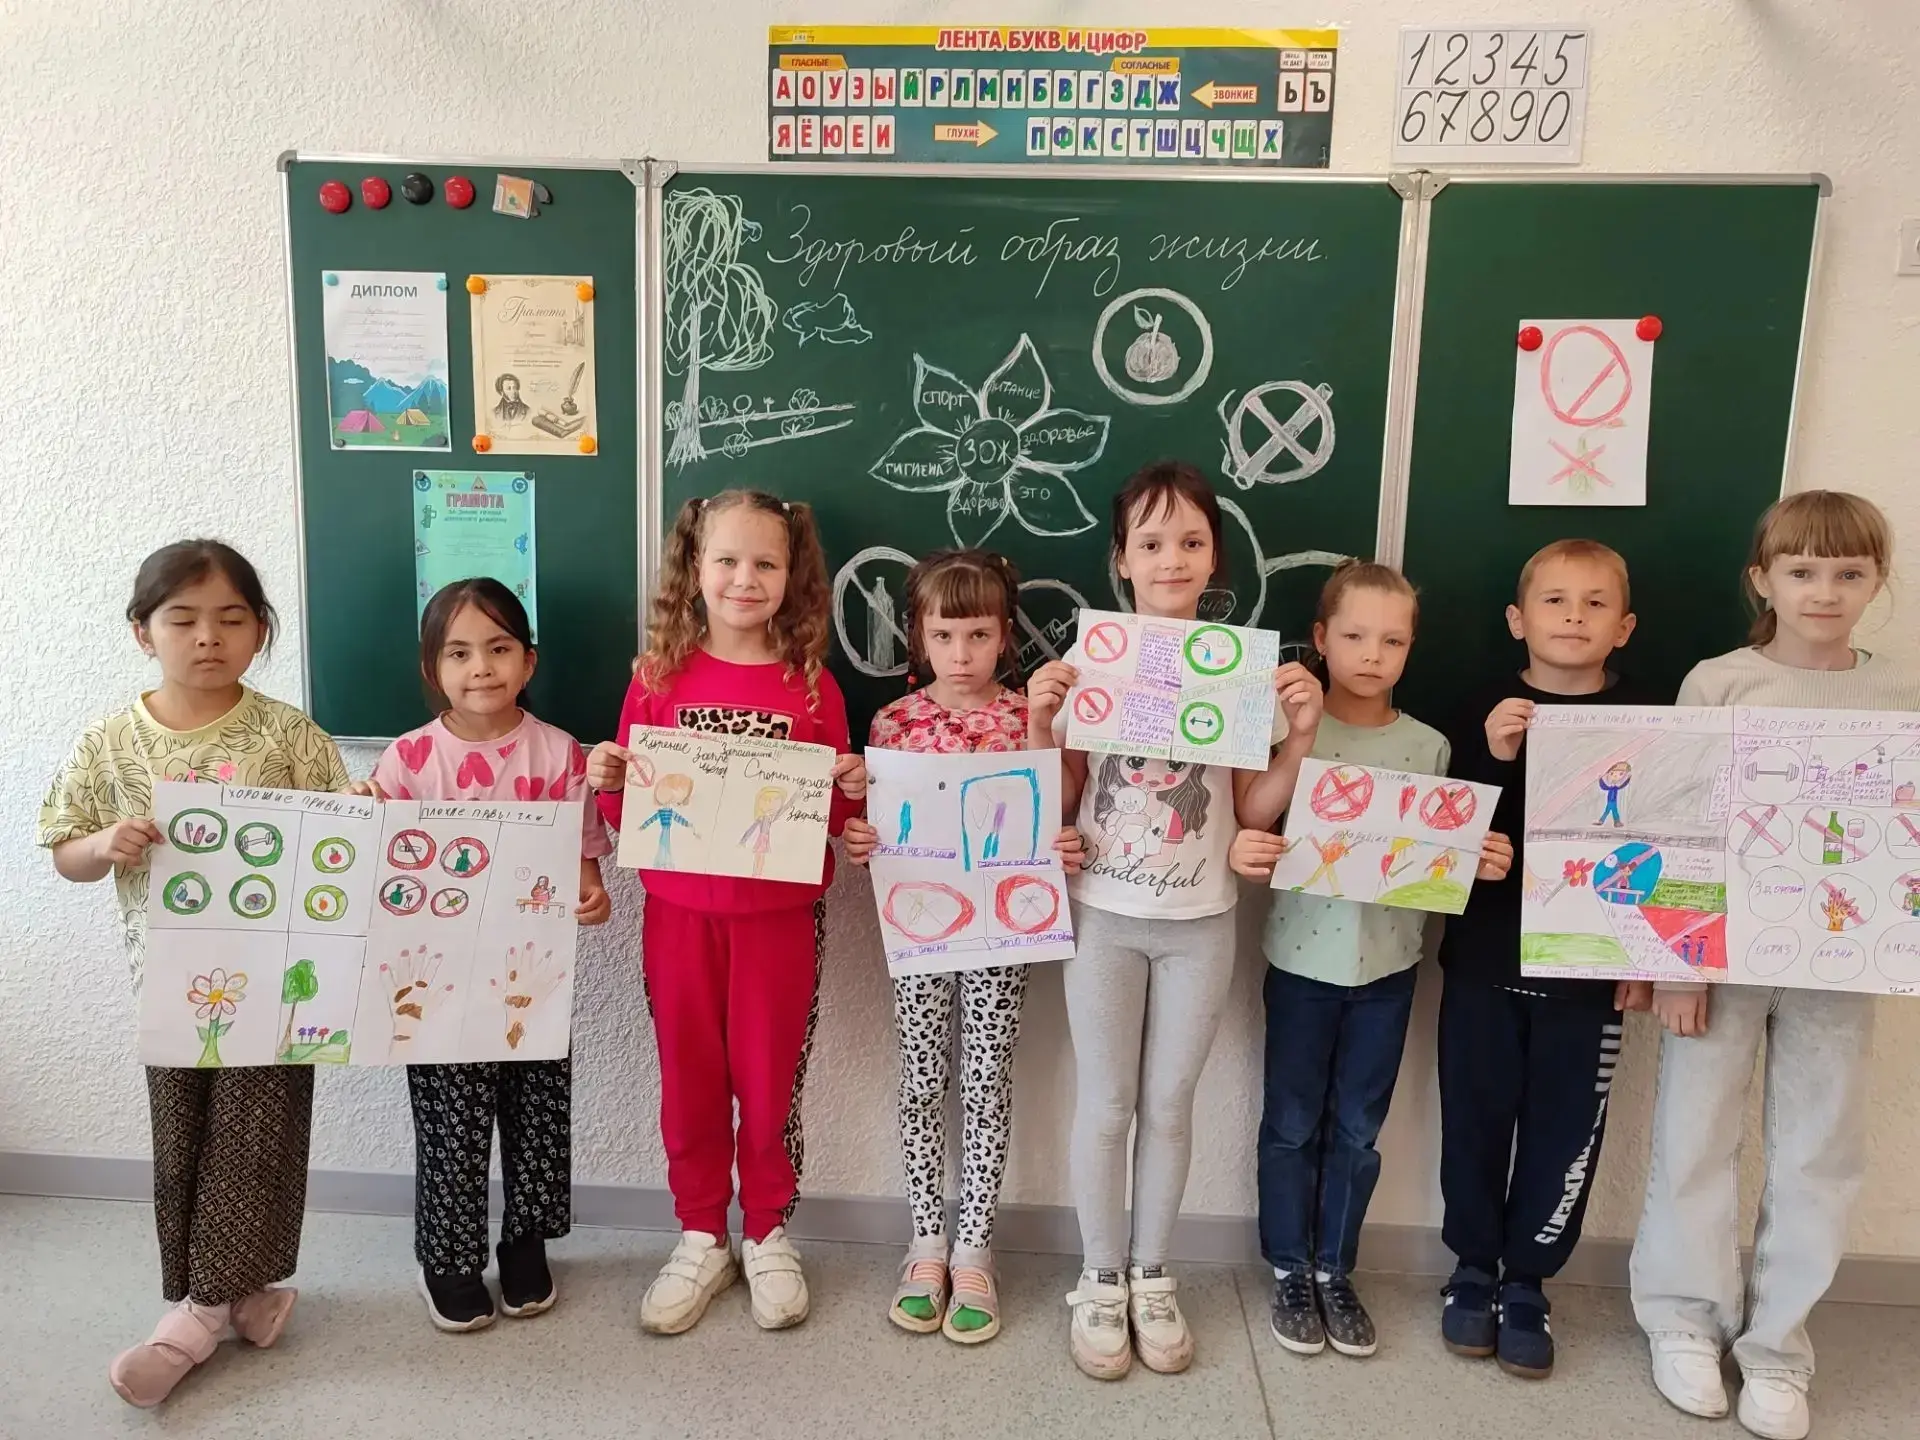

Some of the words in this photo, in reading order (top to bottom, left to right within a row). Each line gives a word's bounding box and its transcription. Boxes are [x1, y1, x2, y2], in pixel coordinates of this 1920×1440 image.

[938, 30, 1002, 49] ЛЕНТА
[1008, 31, 1061, 49] БУКВ
[1067, 32, 1080, 49] И
[1087, 32, 1147, 53] ЦИФР
[791, 58, 830, 67] ГЛАСНЫЕ
[1120, 61, 1171, 70] СОГЛАСНЫЕ
[1213, 89, 1254, 100] ЗВОНКИЕ
[946, 128, 980, 139] ГЛУХИЕ
[766, 204, 979, 290] Здоровый
[1000, 217, 1121, 299] образ
[350, 284, 418, 299] ДИПЛОМ
[498, 295, 568, 325] Грамота
[960, 438, 1012, 468] ЗОЖ
[446, 493, 504, 509] ГРАМОТА
[1020, 486, 1051, 501] ЭТО
